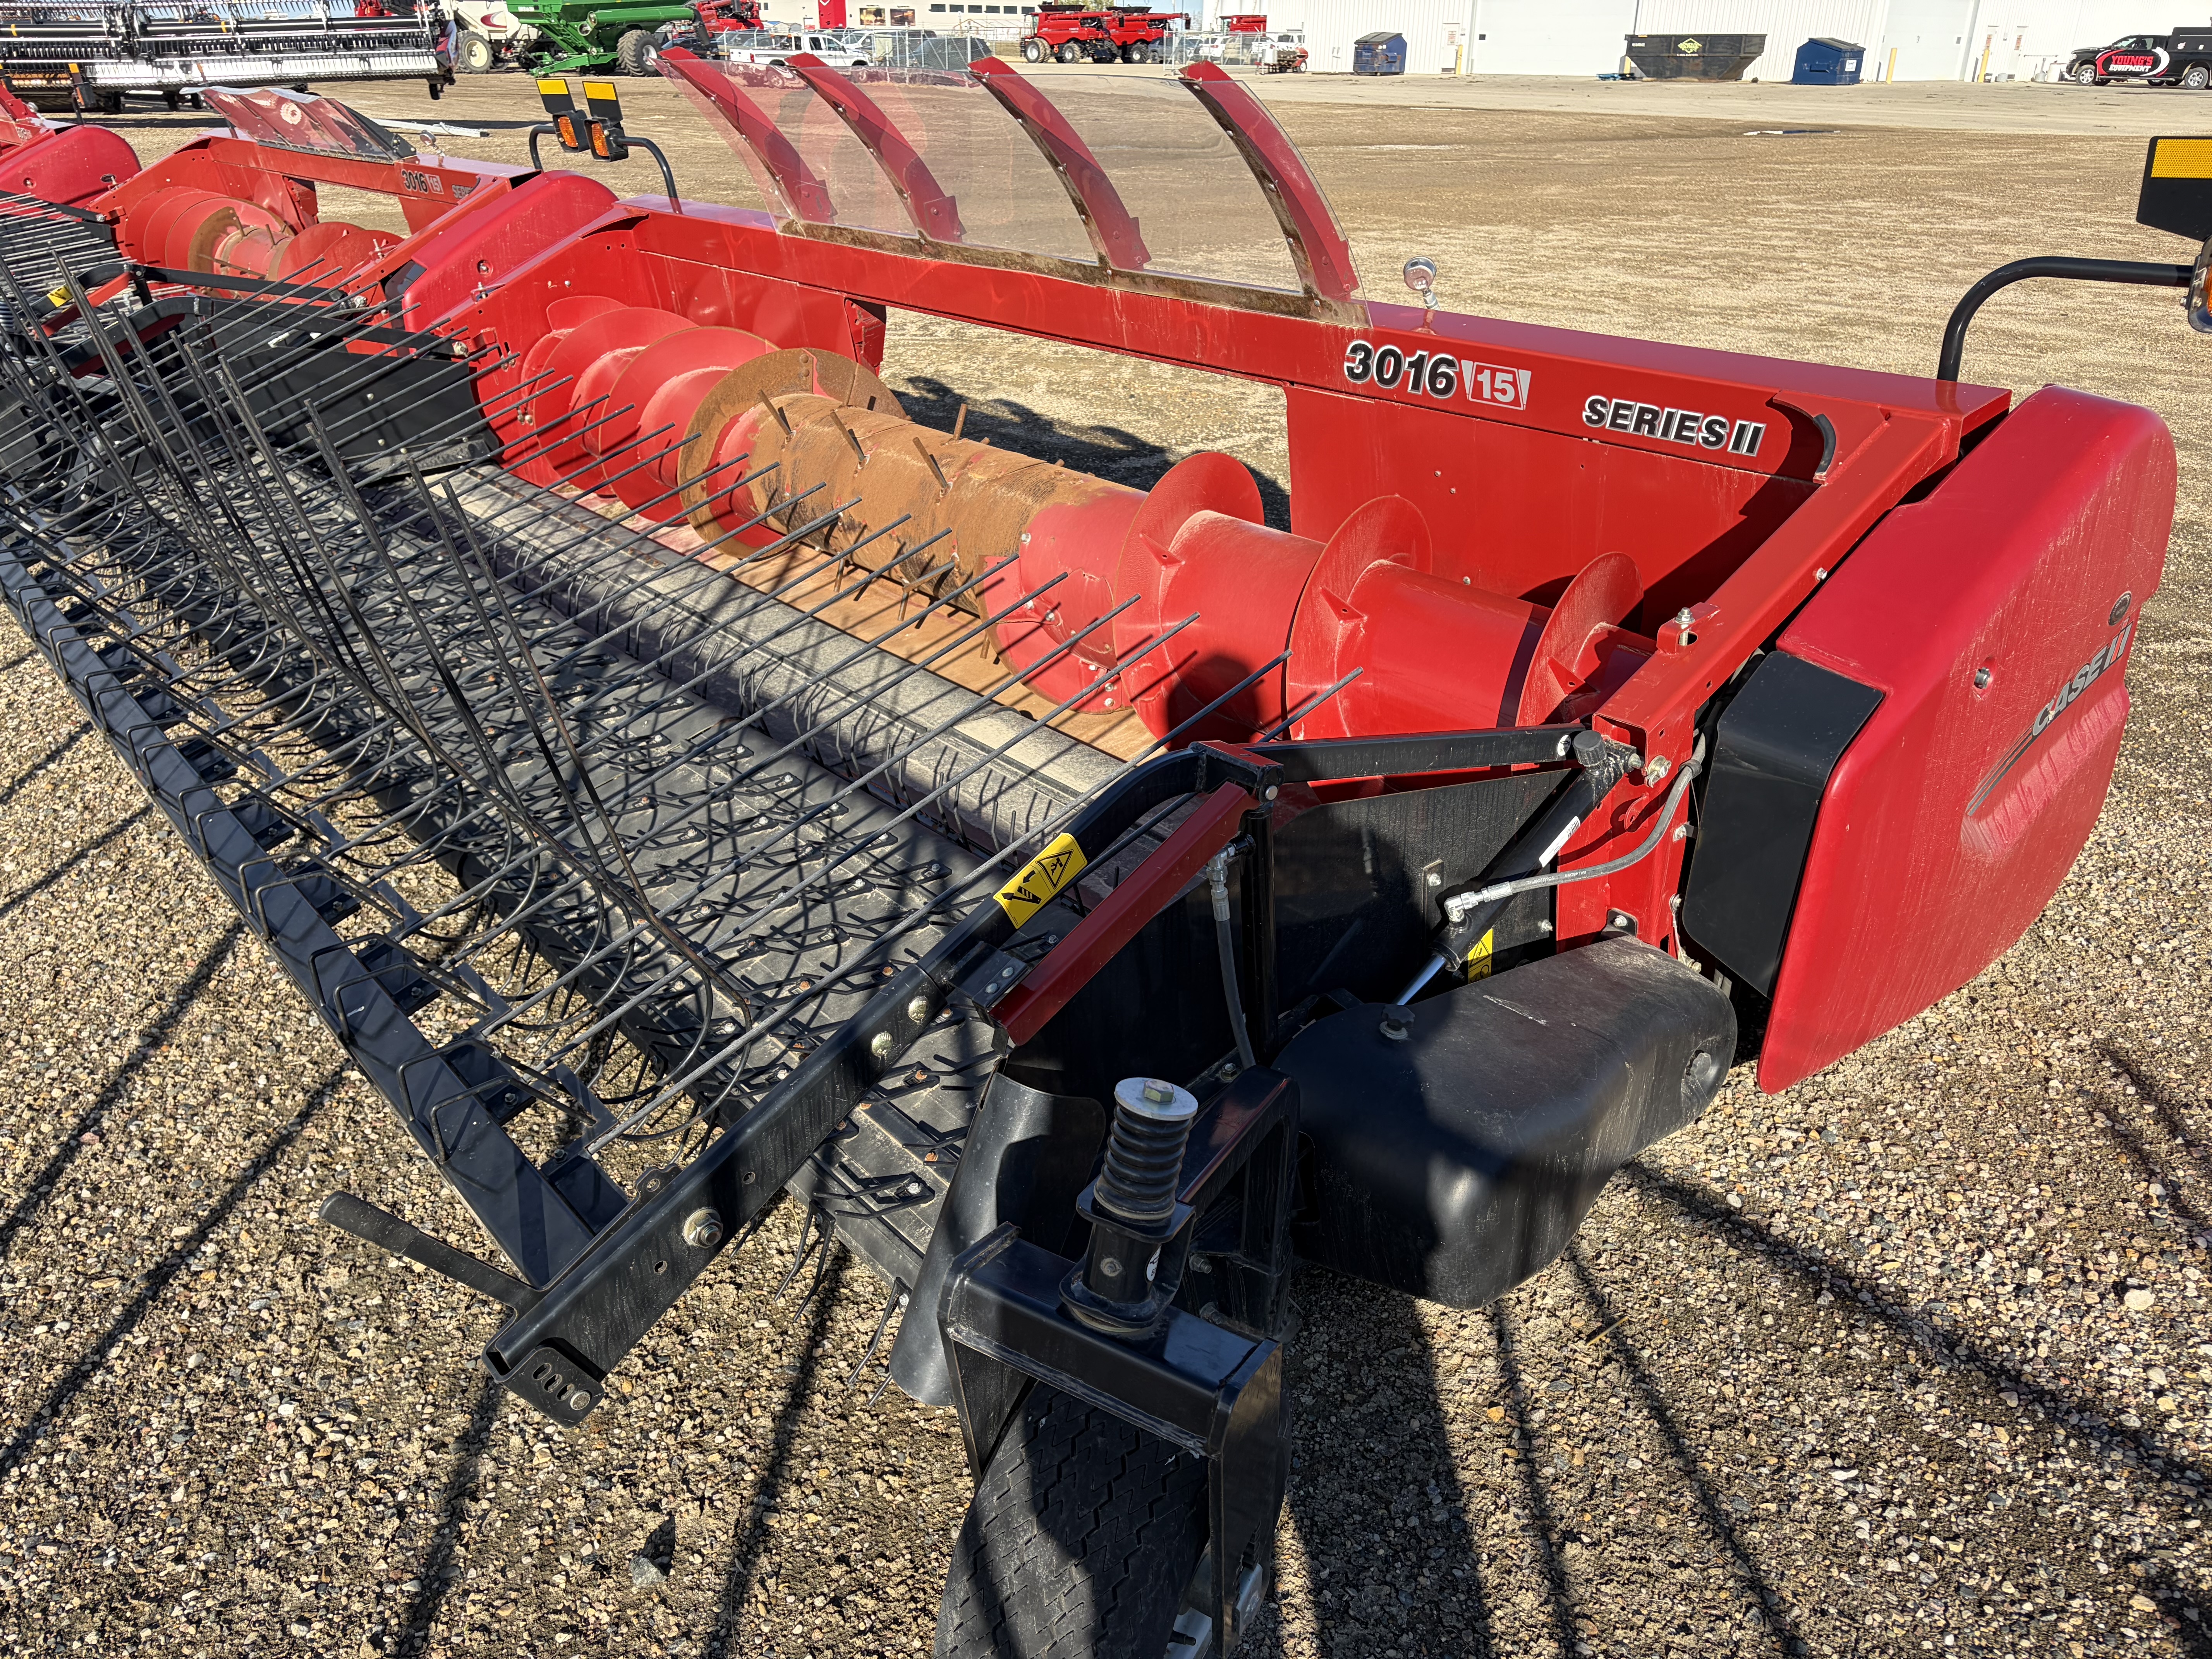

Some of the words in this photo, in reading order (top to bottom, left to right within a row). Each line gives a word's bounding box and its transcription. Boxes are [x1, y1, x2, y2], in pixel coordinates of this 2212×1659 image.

[2112, 55, 2154, 65] YOUNG'S
[401, 169, 429, 194] 3016
[429, 177, 440, 192] 15
[1344, 340, 1459, 399] 3016
[1477, 369, 1515, 402] 15
[1582, 395, 1730, 450] SERIES
[1727, 419, 1766, 457] II
